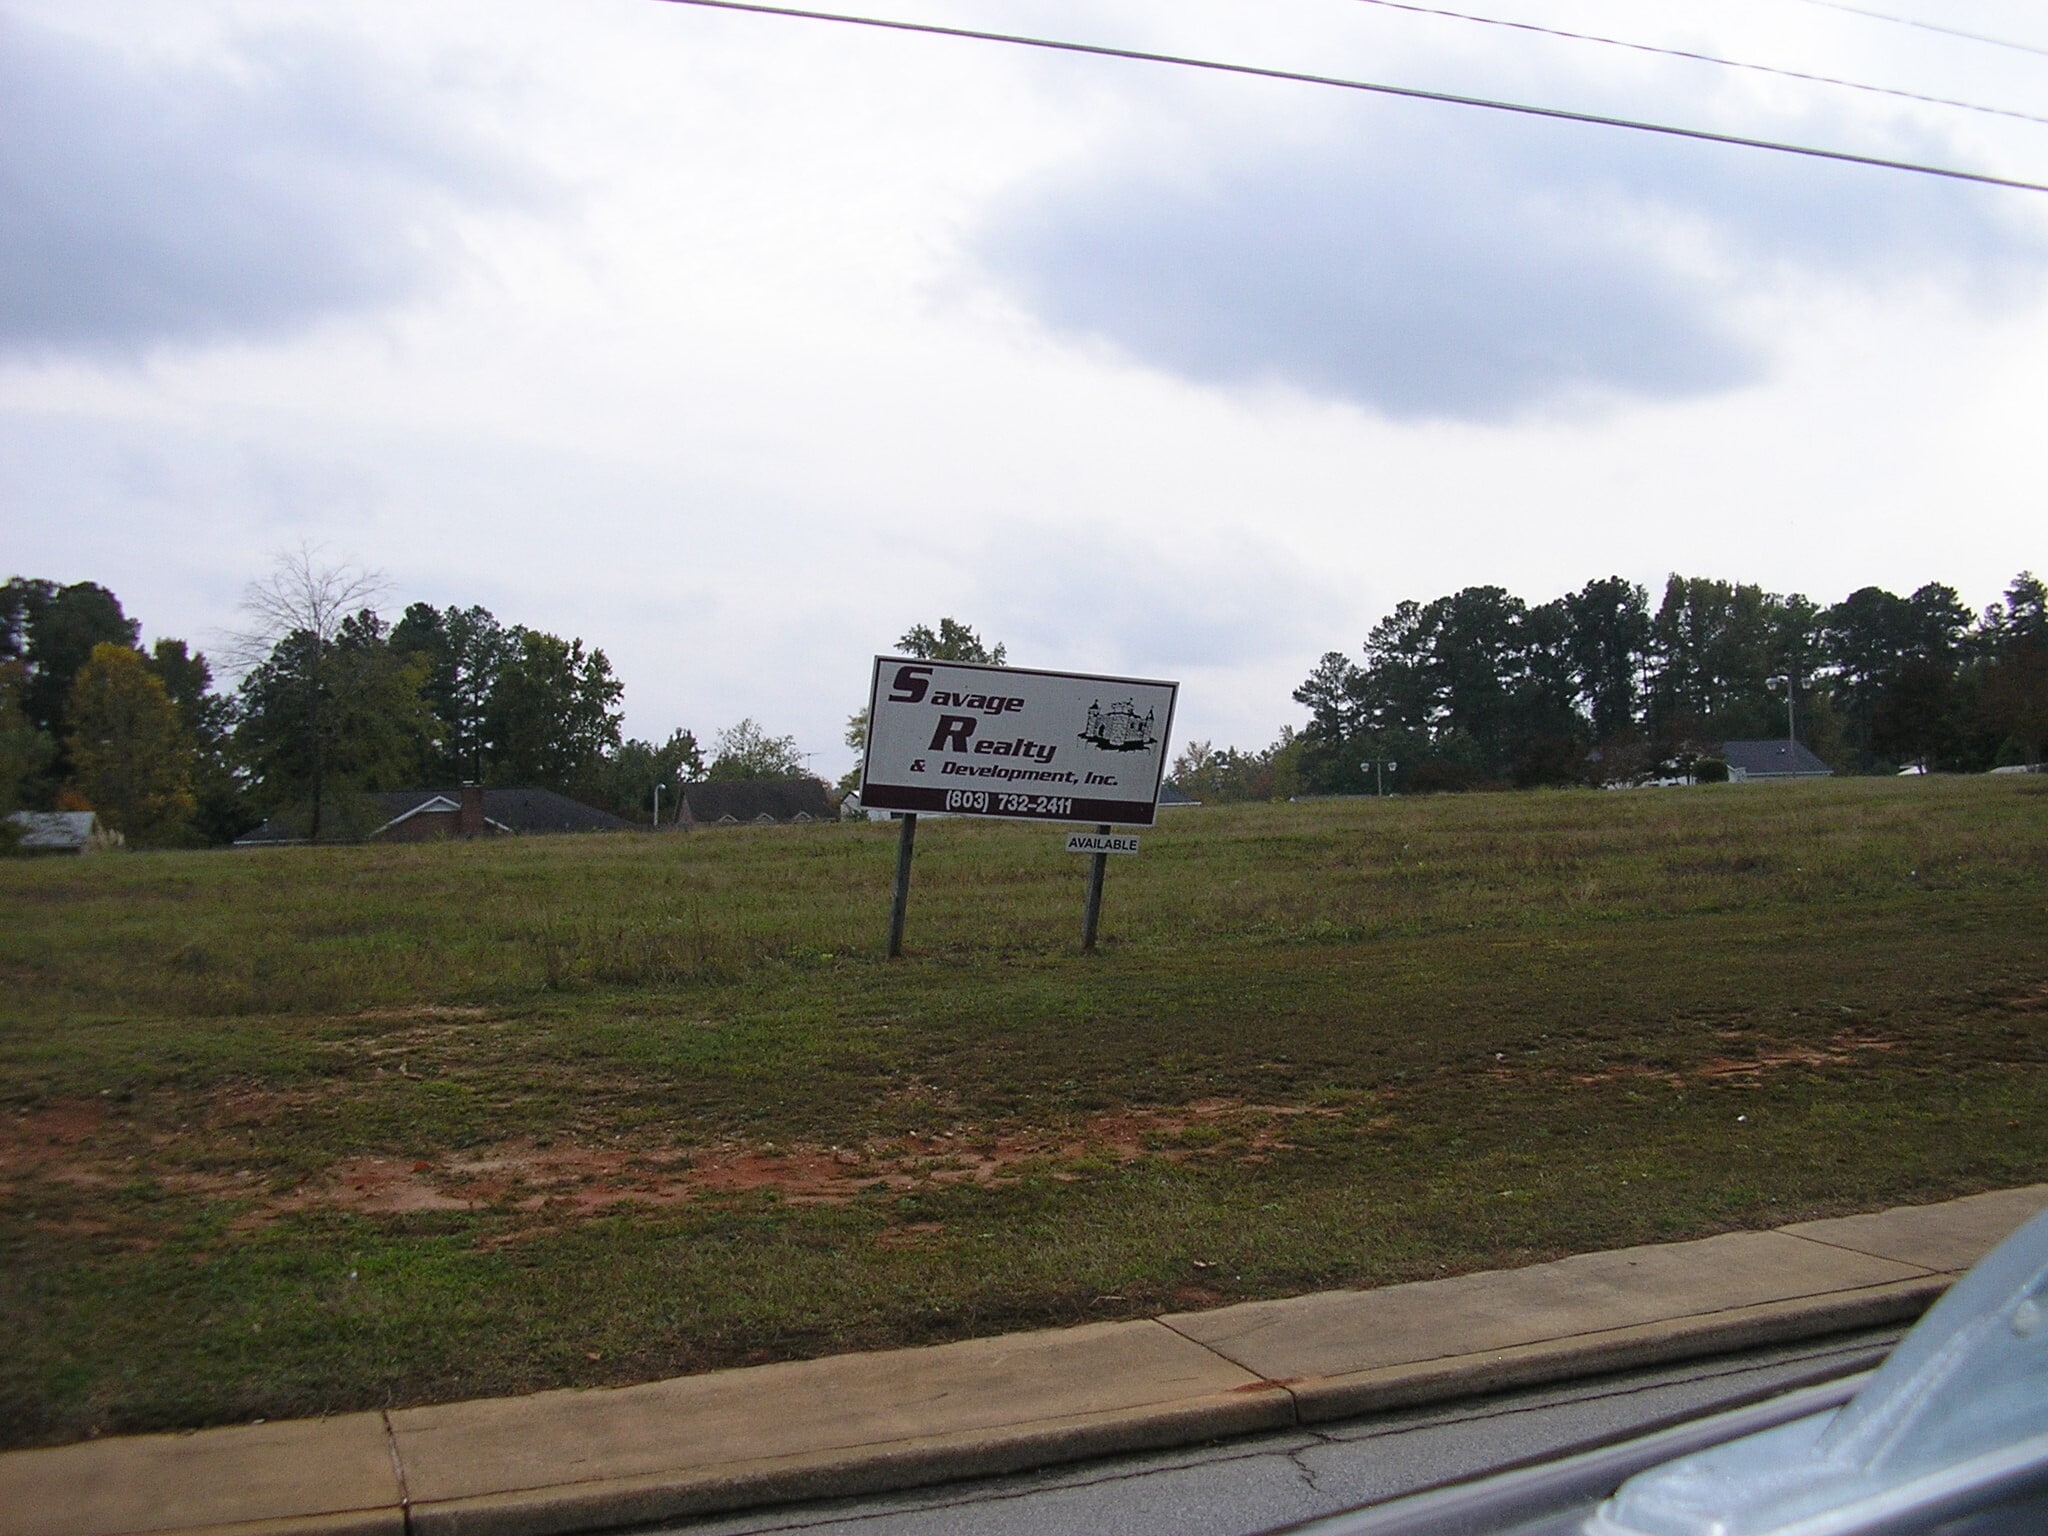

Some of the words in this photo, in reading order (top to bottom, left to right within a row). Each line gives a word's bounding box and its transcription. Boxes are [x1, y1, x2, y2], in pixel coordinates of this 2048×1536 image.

[888, 666, 1025, 714] Savage
[928, 714, 1057, 763] Realty
[910, 759, 926, 773] &
[941, 761, 1079, 786] Development,
[1084, 771, 1119, 786] Inc.
[945, 789, 989, 813] (803)
[998, 794, 1072, 814] 732-2411
[1068, 836, 1138, 852] AVAILABLE
